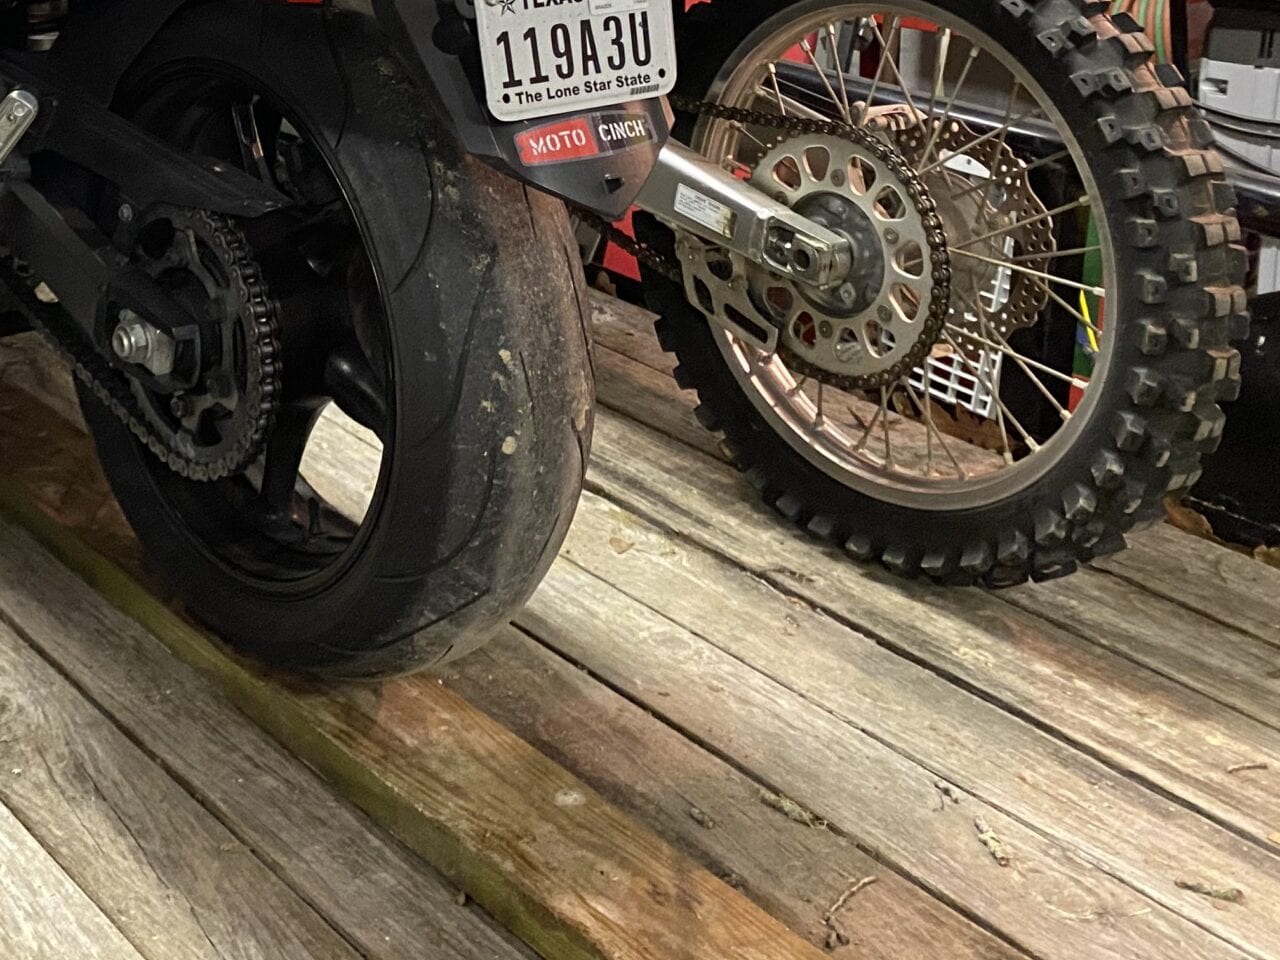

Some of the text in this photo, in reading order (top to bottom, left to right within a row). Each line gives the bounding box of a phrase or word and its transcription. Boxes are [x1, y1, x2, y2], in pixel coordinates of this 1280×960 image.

[496, 11, 652, 89] 119A3U
[515, 73, 651, 105] The Lone Star State
[529, 120, 646, 156] MOTO CINCH
